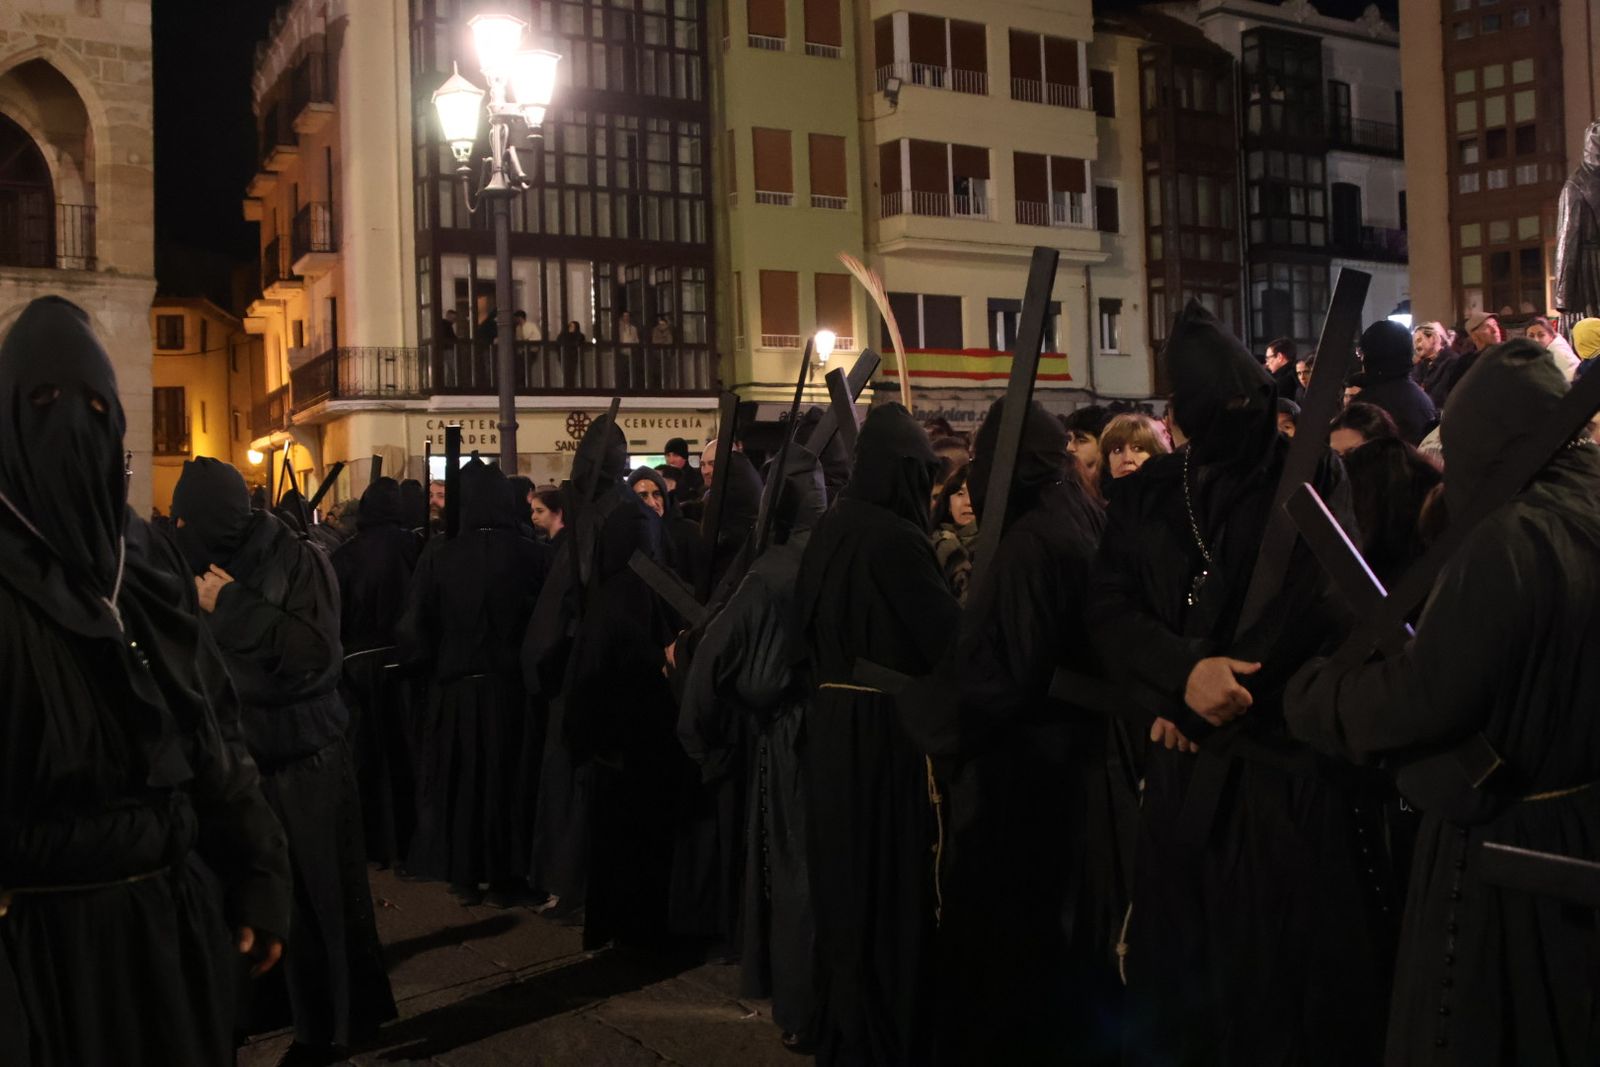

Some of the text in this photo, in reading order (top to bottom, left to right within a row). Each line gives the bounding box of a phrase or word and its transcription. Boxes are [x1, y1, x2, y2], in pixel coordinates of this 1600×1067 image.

[426, 419, 497, 430] CAFETER
[624, 416, 702, 428] CERVECERÍA
[426, 435, 497, 445] HEADER
